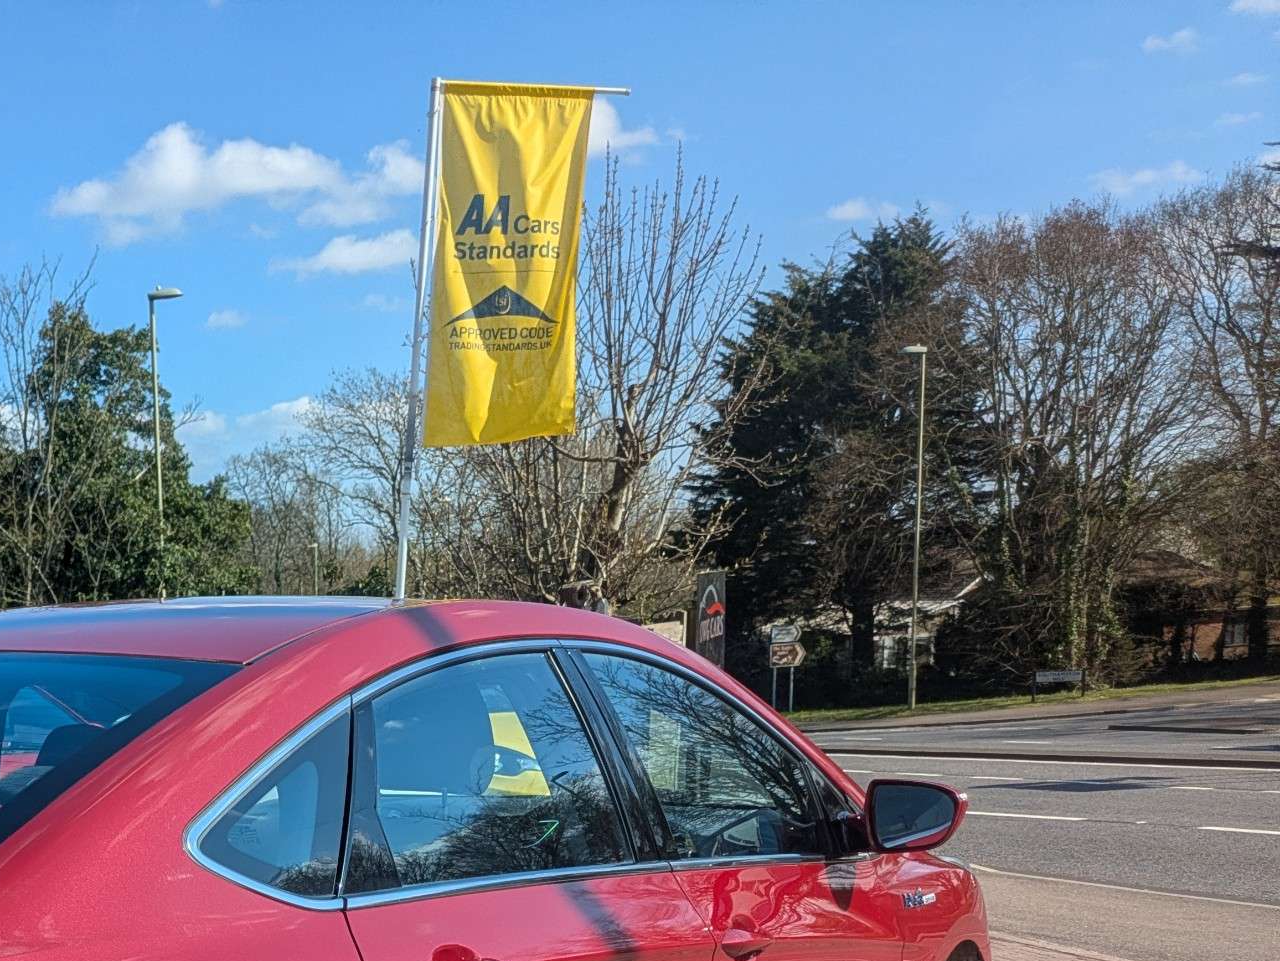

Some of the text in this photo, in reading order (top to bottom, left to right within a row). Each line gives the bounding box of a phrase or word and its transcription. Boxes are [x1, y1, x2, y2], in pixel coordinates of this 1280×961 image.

[455, 194, 560, 236] AA Cars
[454, 241, 560, 261] Standards
[449, 325, 554, 340] APPROVED CODE
